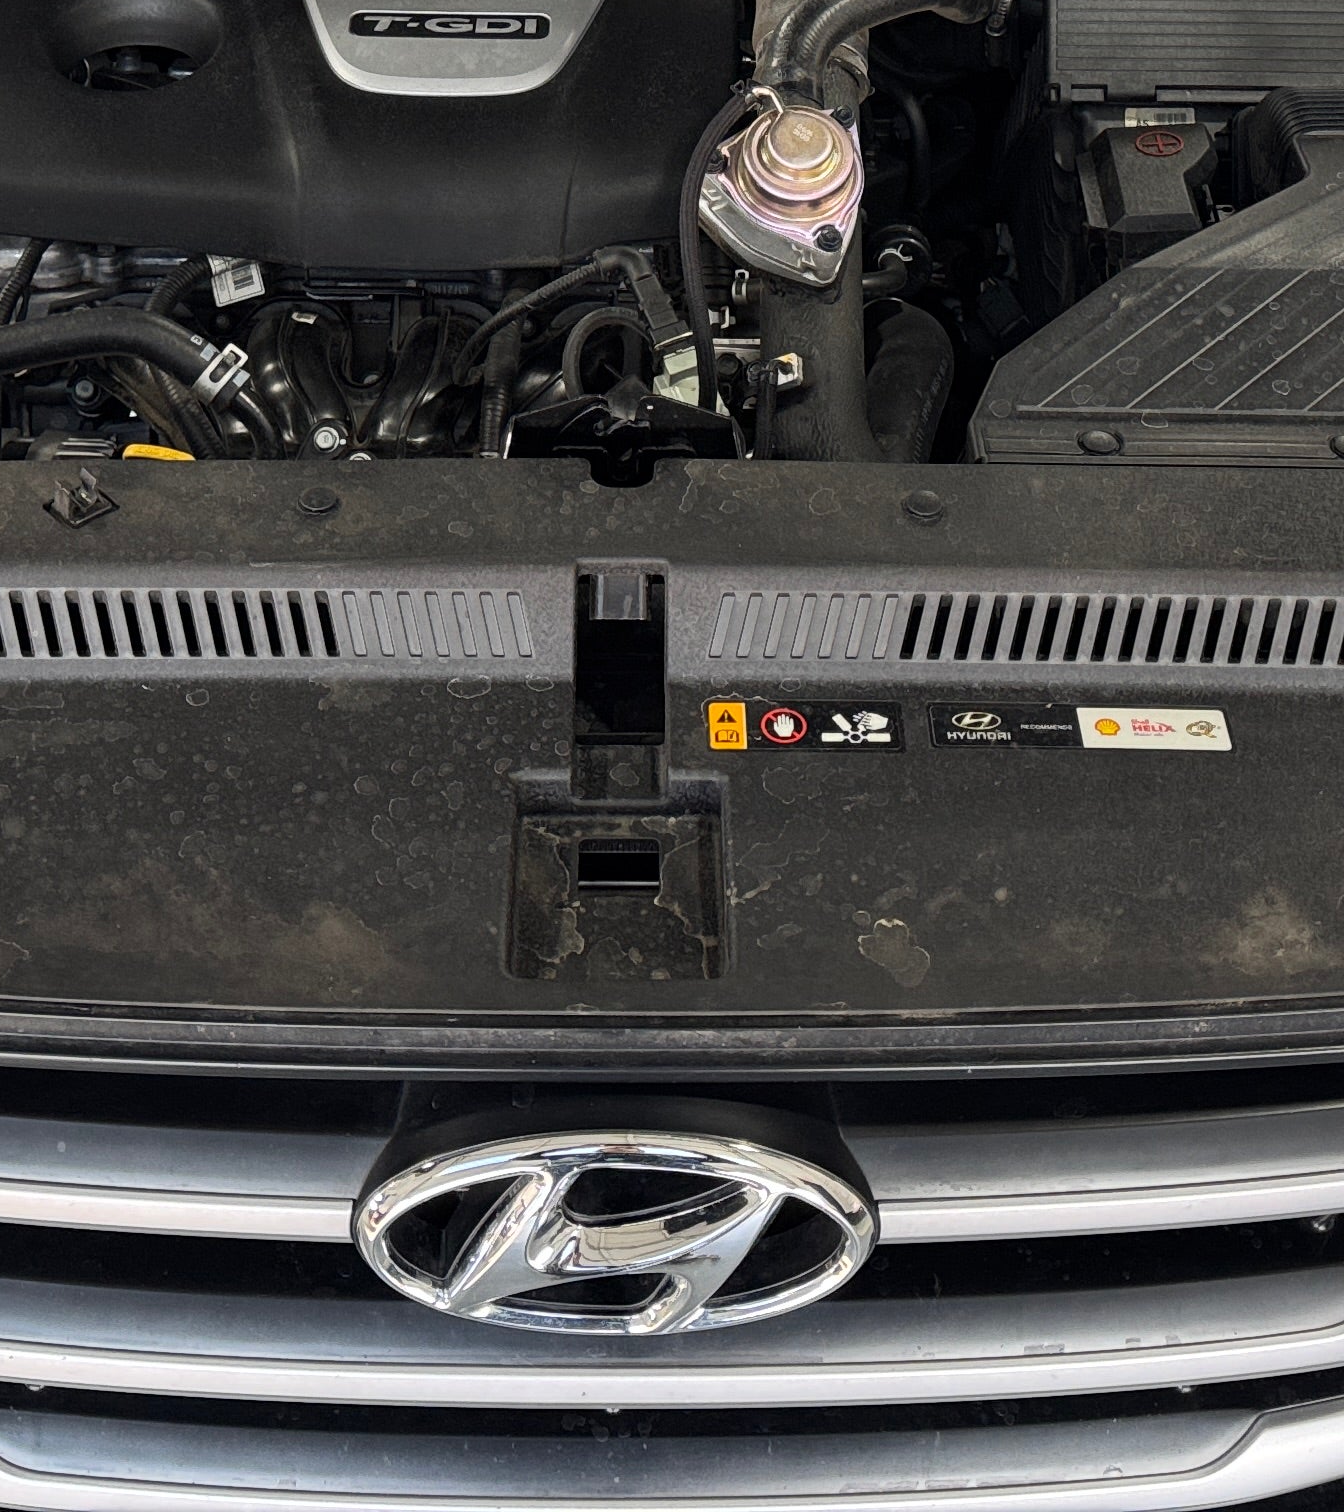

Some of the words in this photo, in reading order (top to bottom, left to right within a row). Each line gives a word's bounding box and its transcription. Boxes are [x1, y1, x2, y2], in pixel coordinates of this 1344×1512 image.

[363, 15, 538, 34] T-GDI
[1132, 724, 1176, 733] HELIX
[946, 731, 1012, 741] HYUNDAI
